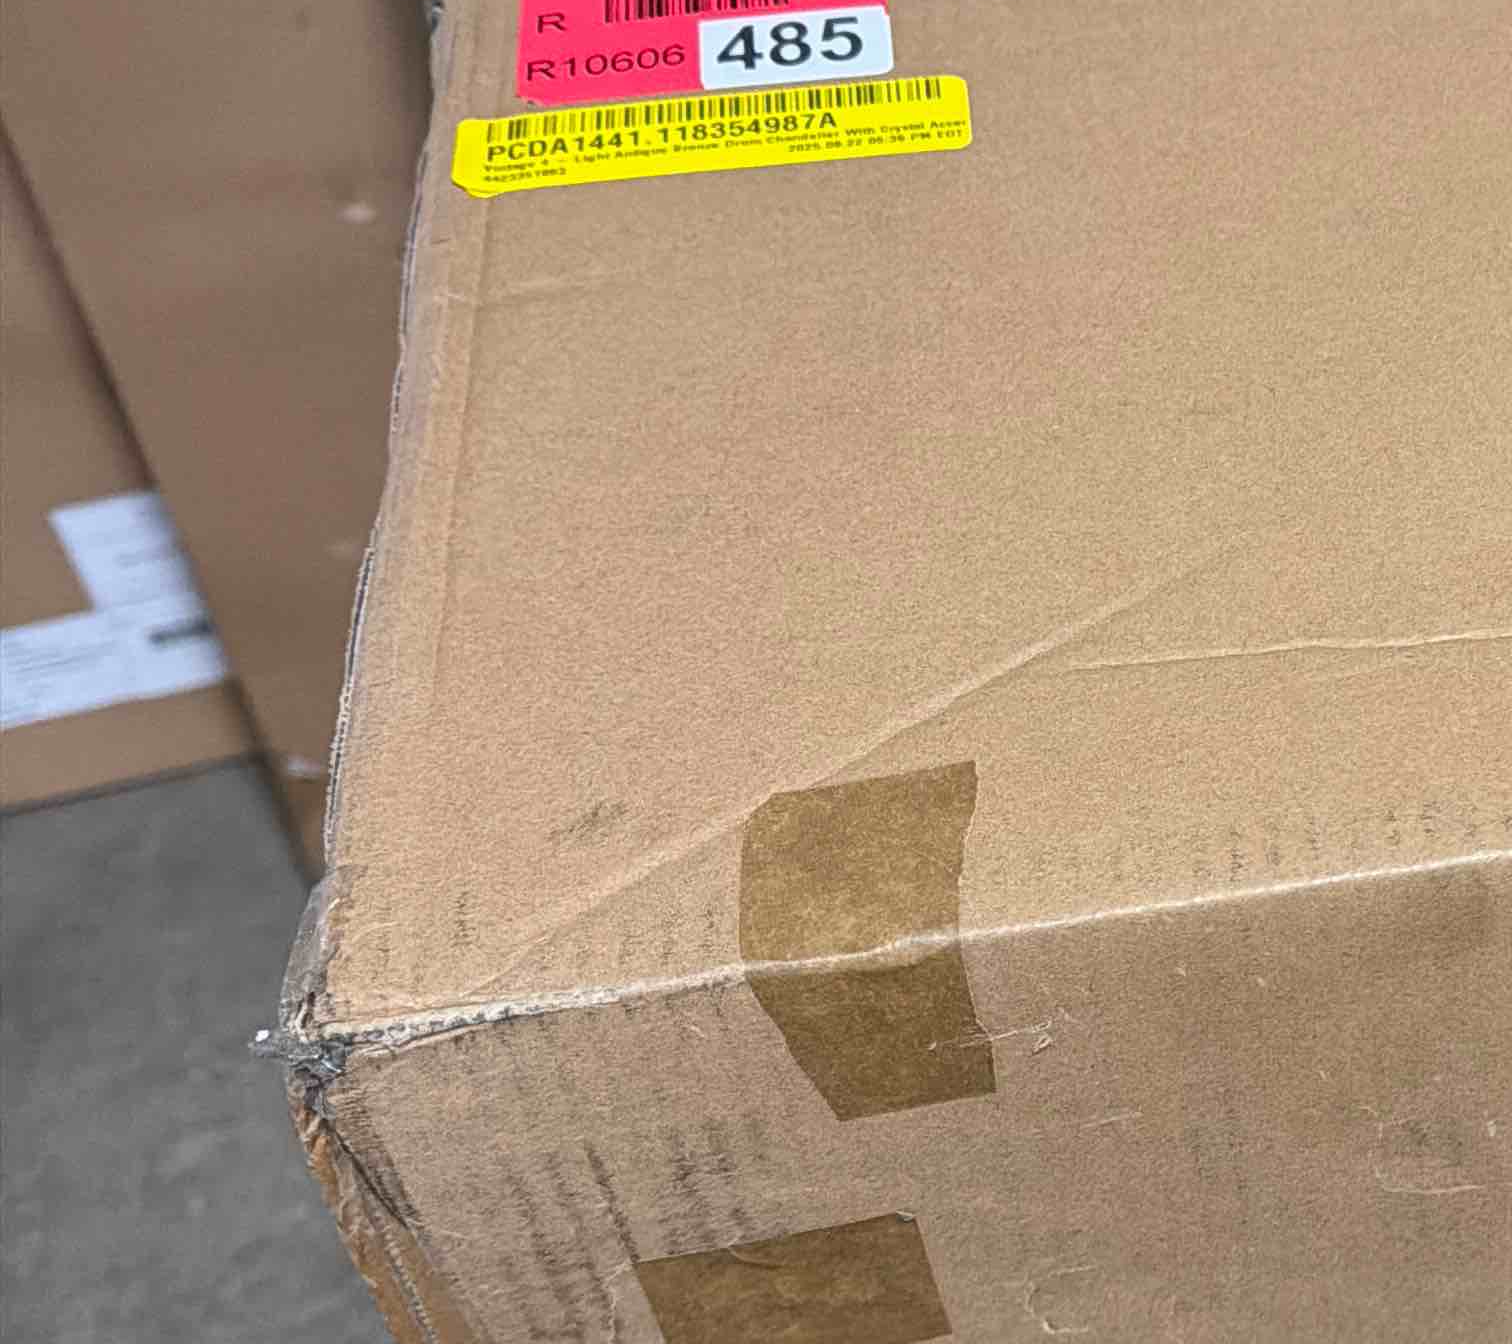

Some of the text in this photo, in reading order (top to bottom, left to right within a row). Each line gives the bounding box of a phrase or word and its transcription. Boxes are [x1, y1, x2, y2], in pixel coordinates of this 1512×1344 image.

[536, 12, 567, 34] R
[526, 15, 864, 82] R10606 485
[487, 111, 838, 163] PCDA1441.118354987A
[725, 136, 763, 149] Drum
[845, 125, 875, 137] With
